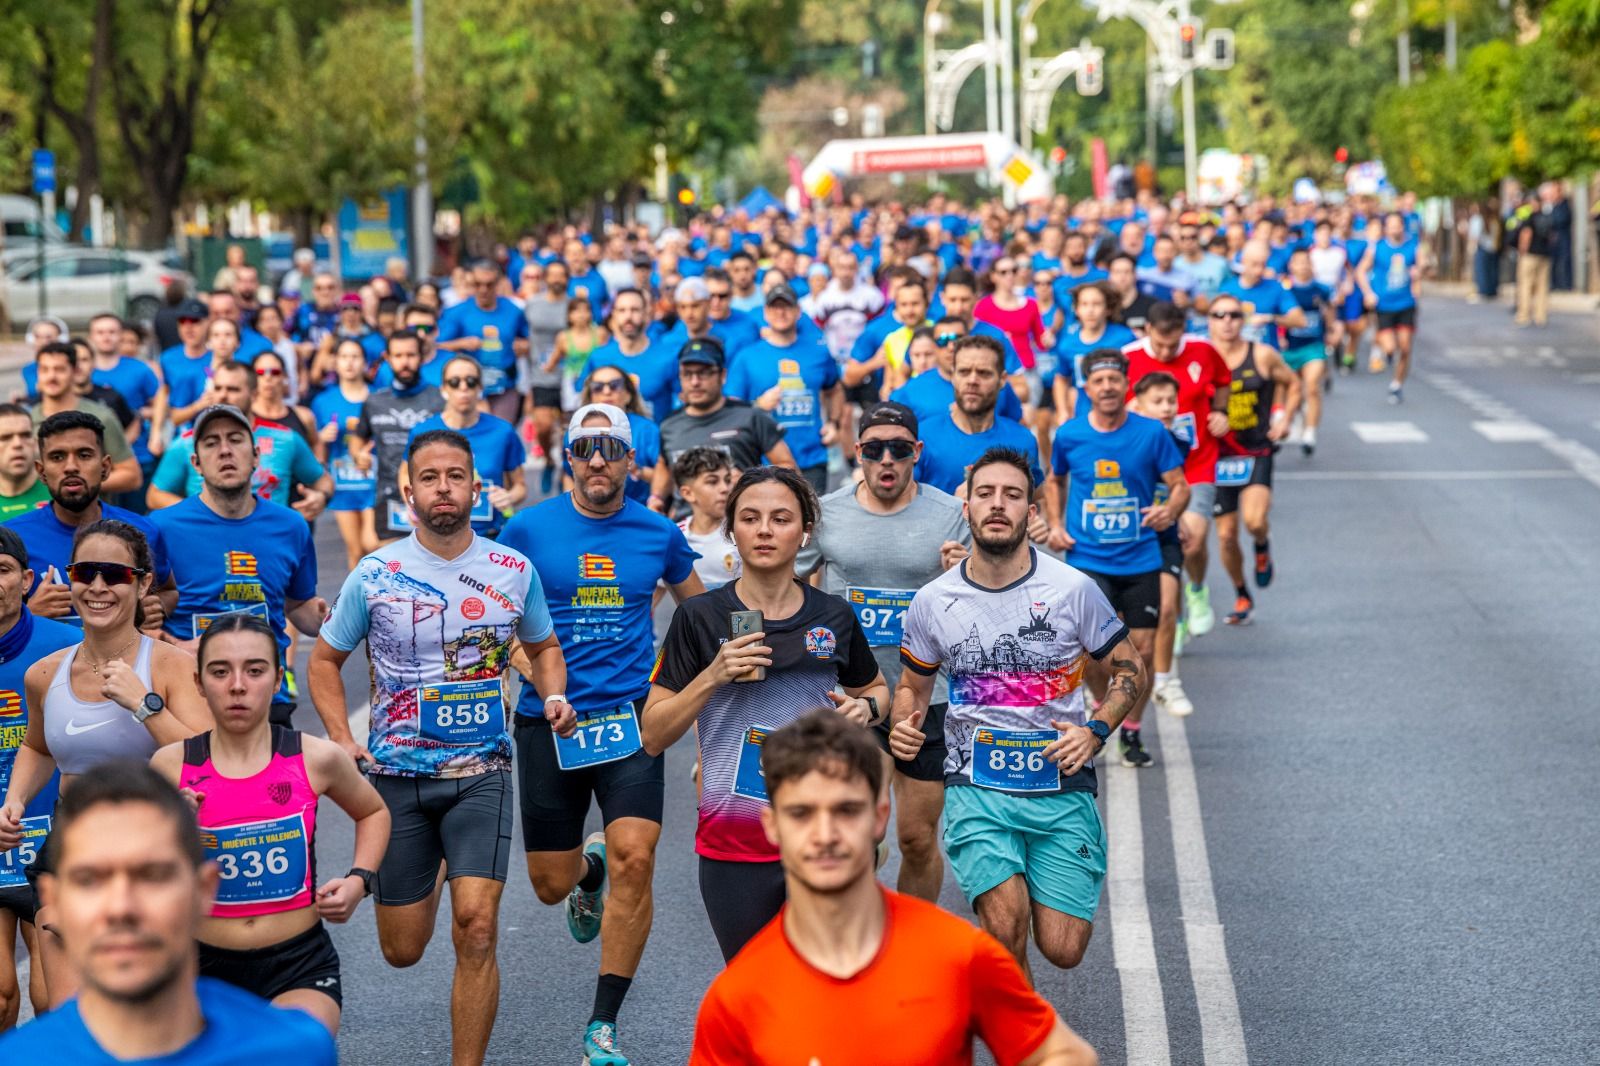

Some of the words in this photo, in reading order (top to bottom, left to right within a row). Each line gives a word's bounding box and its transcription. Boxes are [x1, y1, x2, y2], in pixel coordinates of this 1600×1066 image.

[1093, 513, 1130, 531] 679
[571, 596, 578, 607] X
[580, 596, 625, 607] VALENCIA
[860, 608, 908, 629] 971
[436, 702, 490, 727] 858
[572, 723, 625, 749] 173
[988, 749, 1044, 772] 836
[258, 837, 265, 845] X
[265, 829, 302, 843] VALENCIA
[216, 846, 289, 880] 336
[246, 880, 263, 888] ANA
